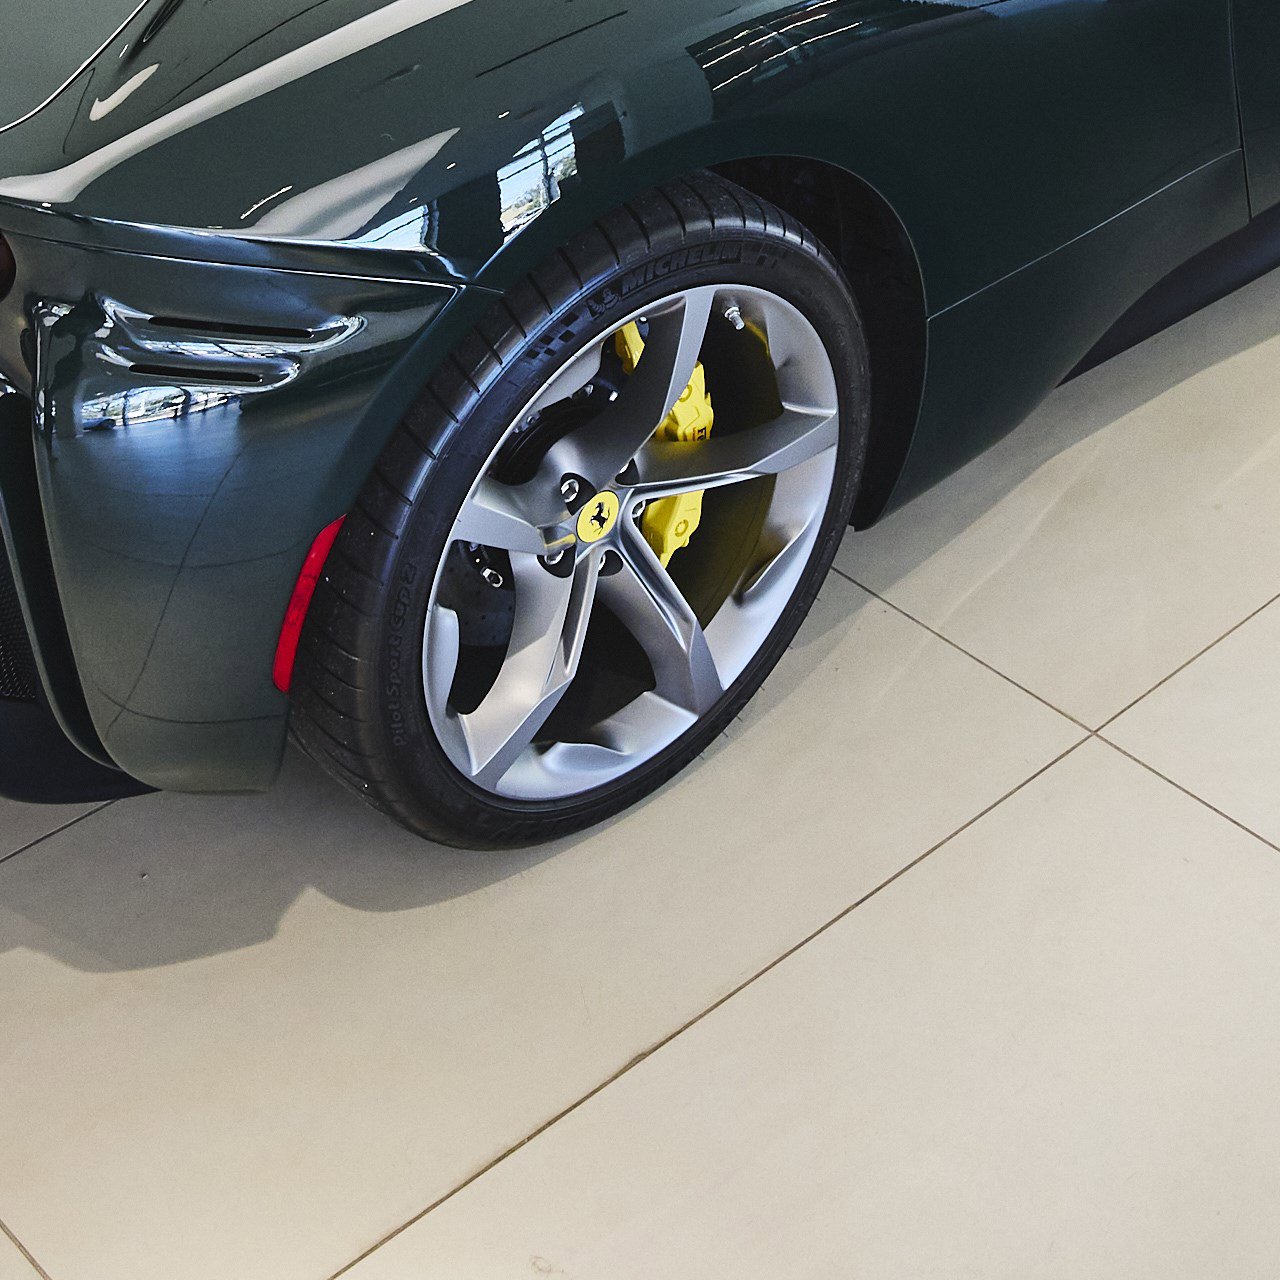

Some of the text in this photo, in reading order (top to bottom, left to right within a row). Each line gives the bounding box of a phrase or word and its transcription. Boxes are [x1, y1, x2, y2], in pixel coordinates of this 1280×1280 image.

[622, 239, 742, 293] MICHELIN
[385, 634, 403, 697] Sport
[387, 701, 407, 747] Pilot
